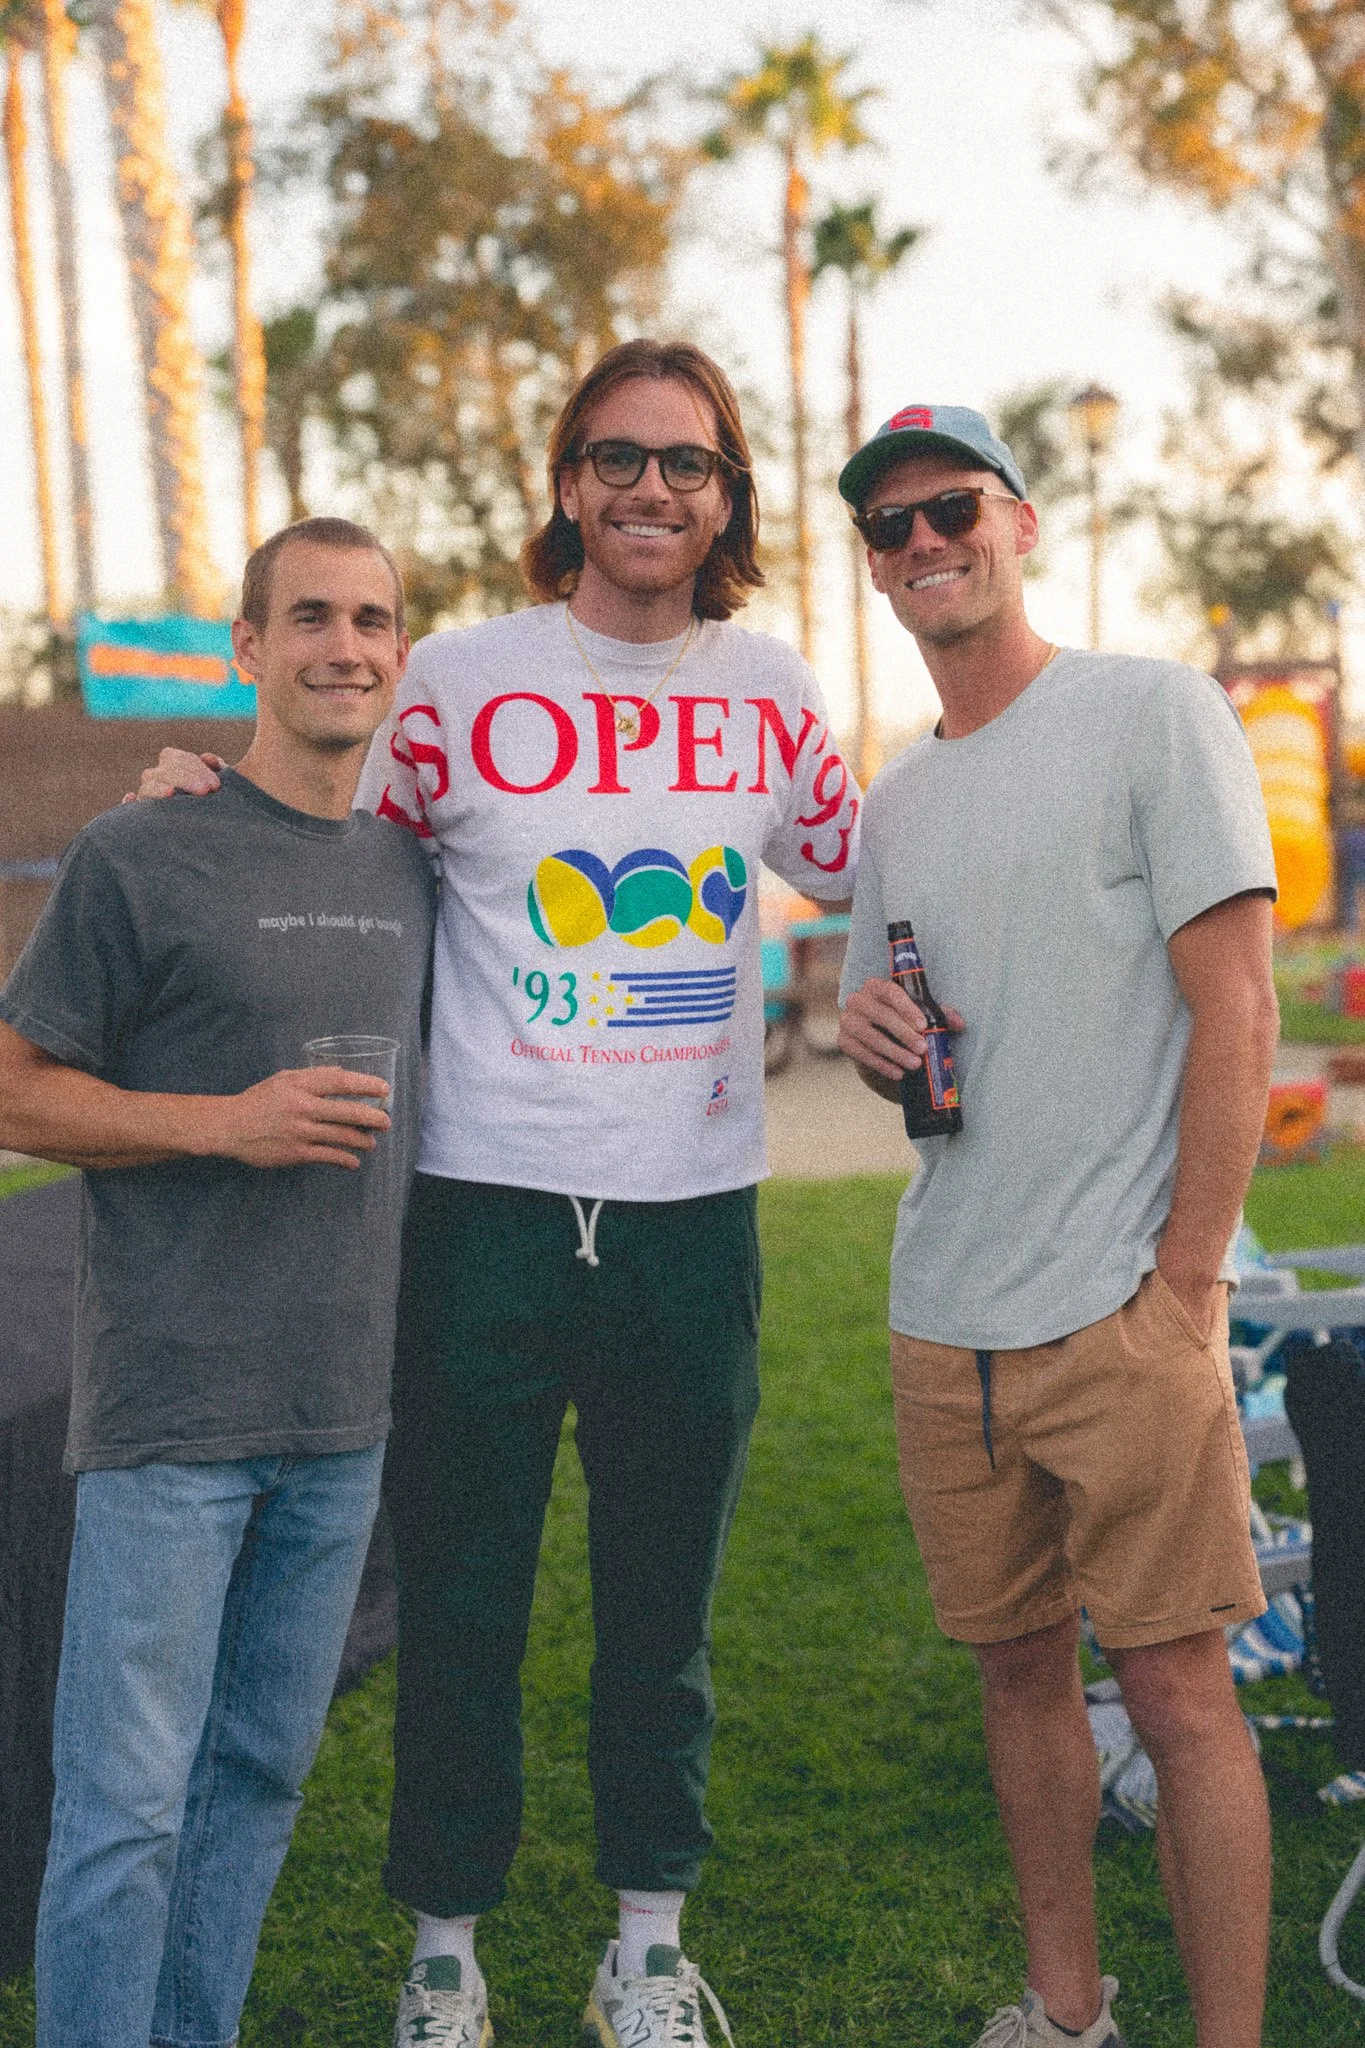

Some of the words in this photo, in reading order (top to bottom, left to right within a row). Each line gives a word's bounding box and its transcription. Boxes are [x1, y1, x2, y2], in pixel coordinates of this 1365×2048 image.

[470, 691, 819, 796] OPEN
[257, 913, 306, 932] maybe
[317, 912, 356, 928] should
[512, 966, 579, 1026] '93
[580, 1044, 636, 1064] TENNIS
[640, 1036, 732, 1064] CHAMPION
